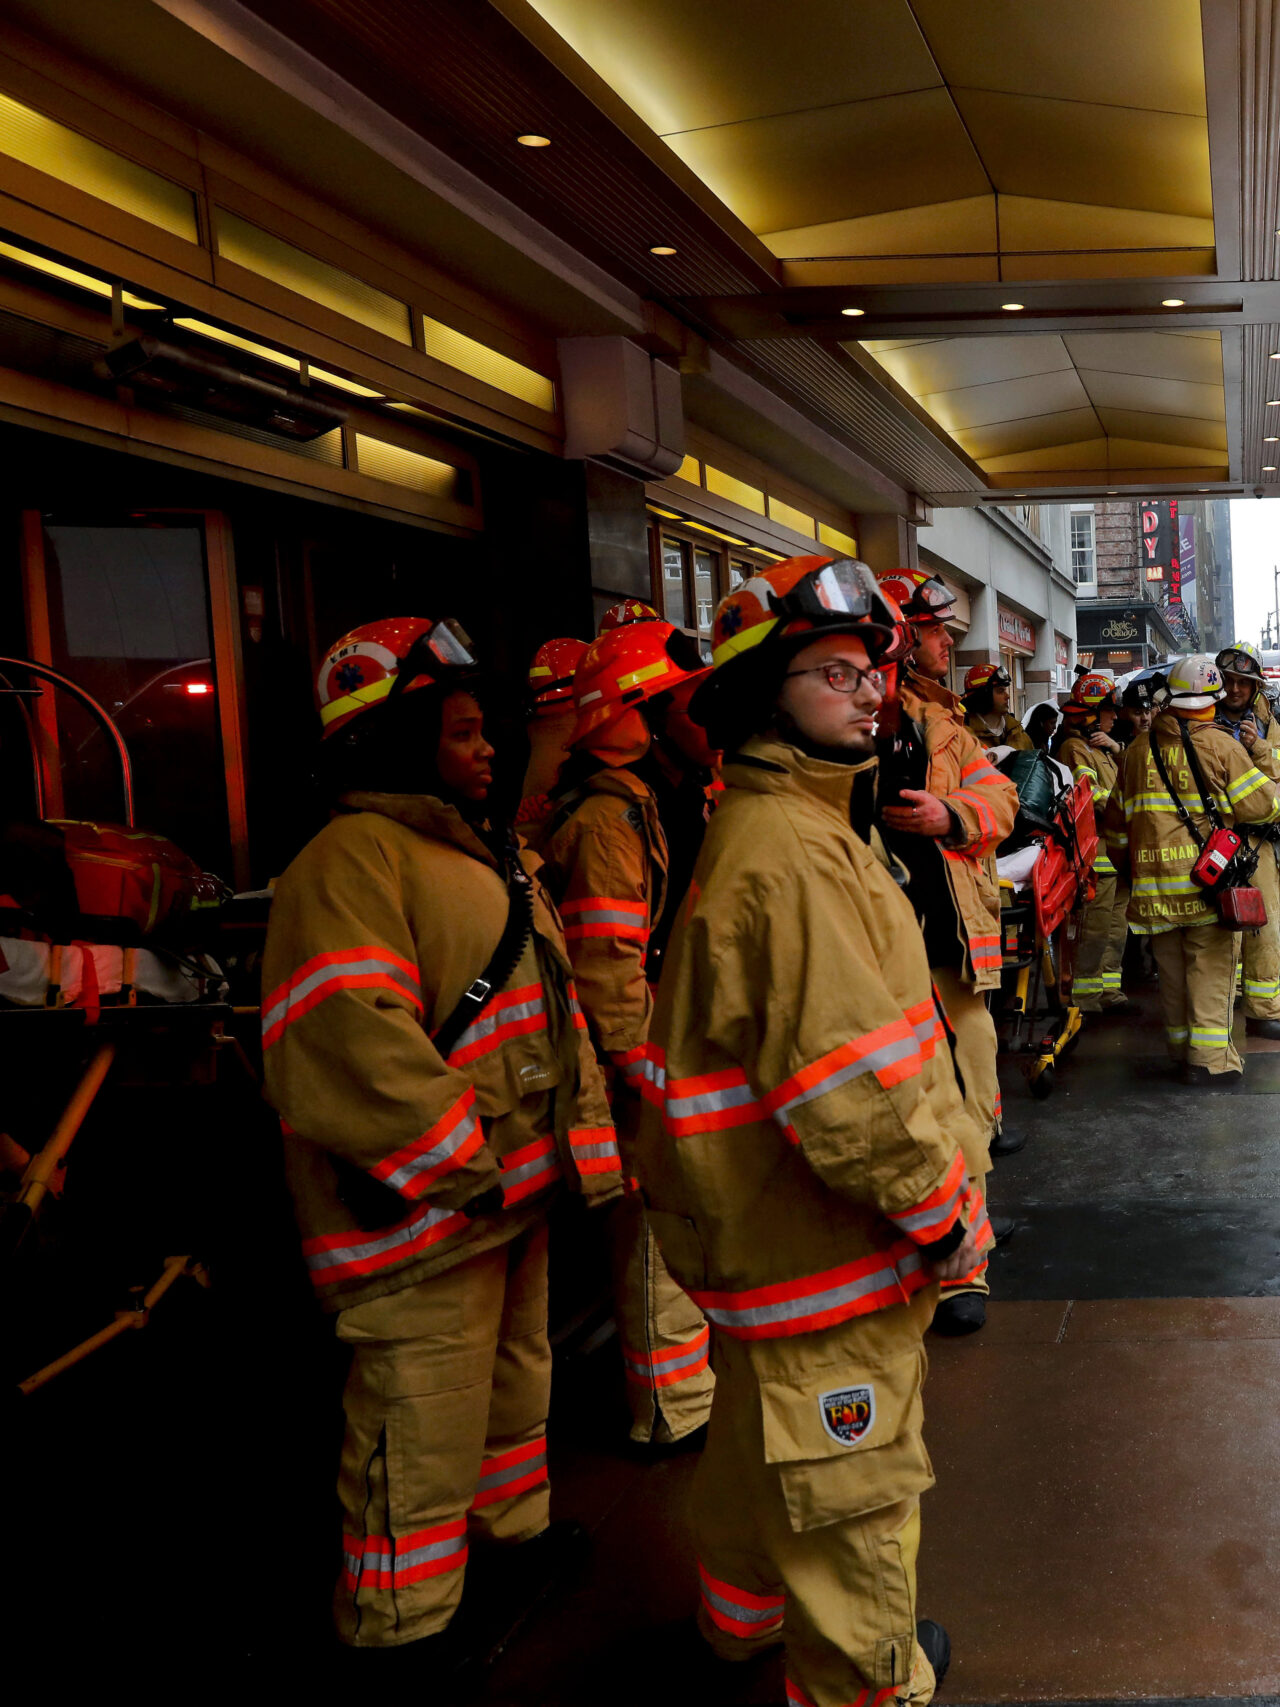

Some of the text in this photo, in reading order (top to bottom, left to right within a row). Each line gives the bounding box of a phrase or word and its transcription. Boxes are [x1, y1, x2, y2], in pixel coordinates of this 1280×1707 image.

[1142, 501, 1159, 558] DY
[1146, 566, 1164, 581] BAR
[1135, 844, 1200, 863] LIEUTENANT
